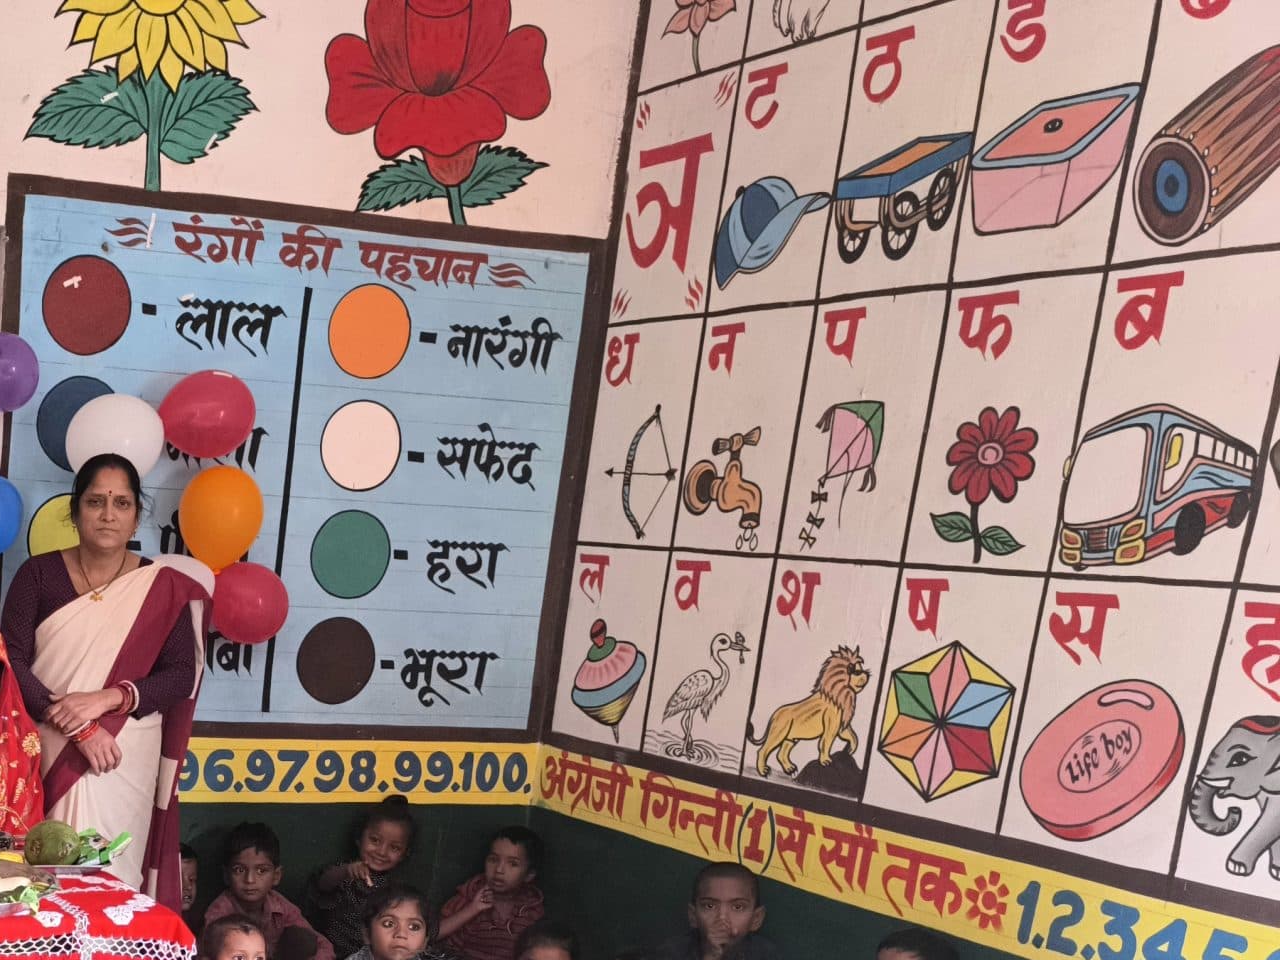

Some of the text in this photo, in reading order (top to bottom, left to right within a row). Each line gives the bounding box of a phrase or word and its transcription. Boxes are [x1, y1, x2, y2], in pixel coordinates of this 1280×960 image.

[862, 25, 915, 103] ठ
[745, 63, 788, 129] ट
[172, 214, 488, 291] रंगों की पहचान
[175, 299, 288, 358] लाल
[823, 307, 867, 367] प
[957, 290, 1020, 359] फ
[1113, 270, 1184, 351] ब
[446, 315, 564, 374] नारंगी
[605, 331, 640, 387] ध
[708, 322, 745, 375] न
[426, 538, 510, 594] हरा
[578, 553, 610, 604] ल
[674, 559, 711, 610] व
[776, 569, 821, 632] श
[906, 577, 949, 636] ष
[1048, 591, 1120, 664] स
[401, 647, 499, 706] भूरा
[540, 751, 633, 822] अंग्रेजी
[881, 842, 967, 919] तक
